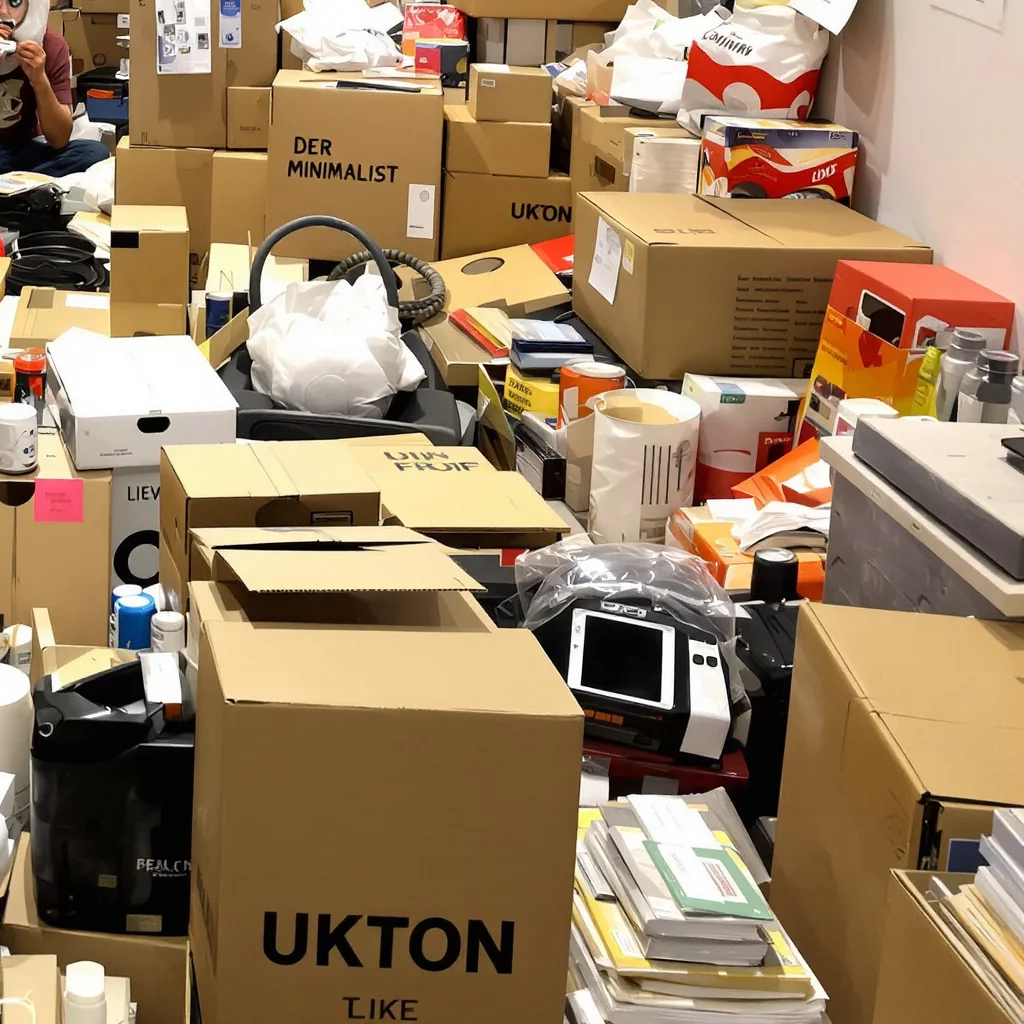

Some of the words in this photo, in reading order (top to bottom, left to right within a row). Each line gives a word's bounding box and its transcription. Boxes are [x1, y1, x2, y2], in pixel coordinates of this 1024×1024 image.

[294, 136, 333, 156] DER
[287, 161, 399, 184] MINIMALIST
[262, 911, 516, 975] UKTON
